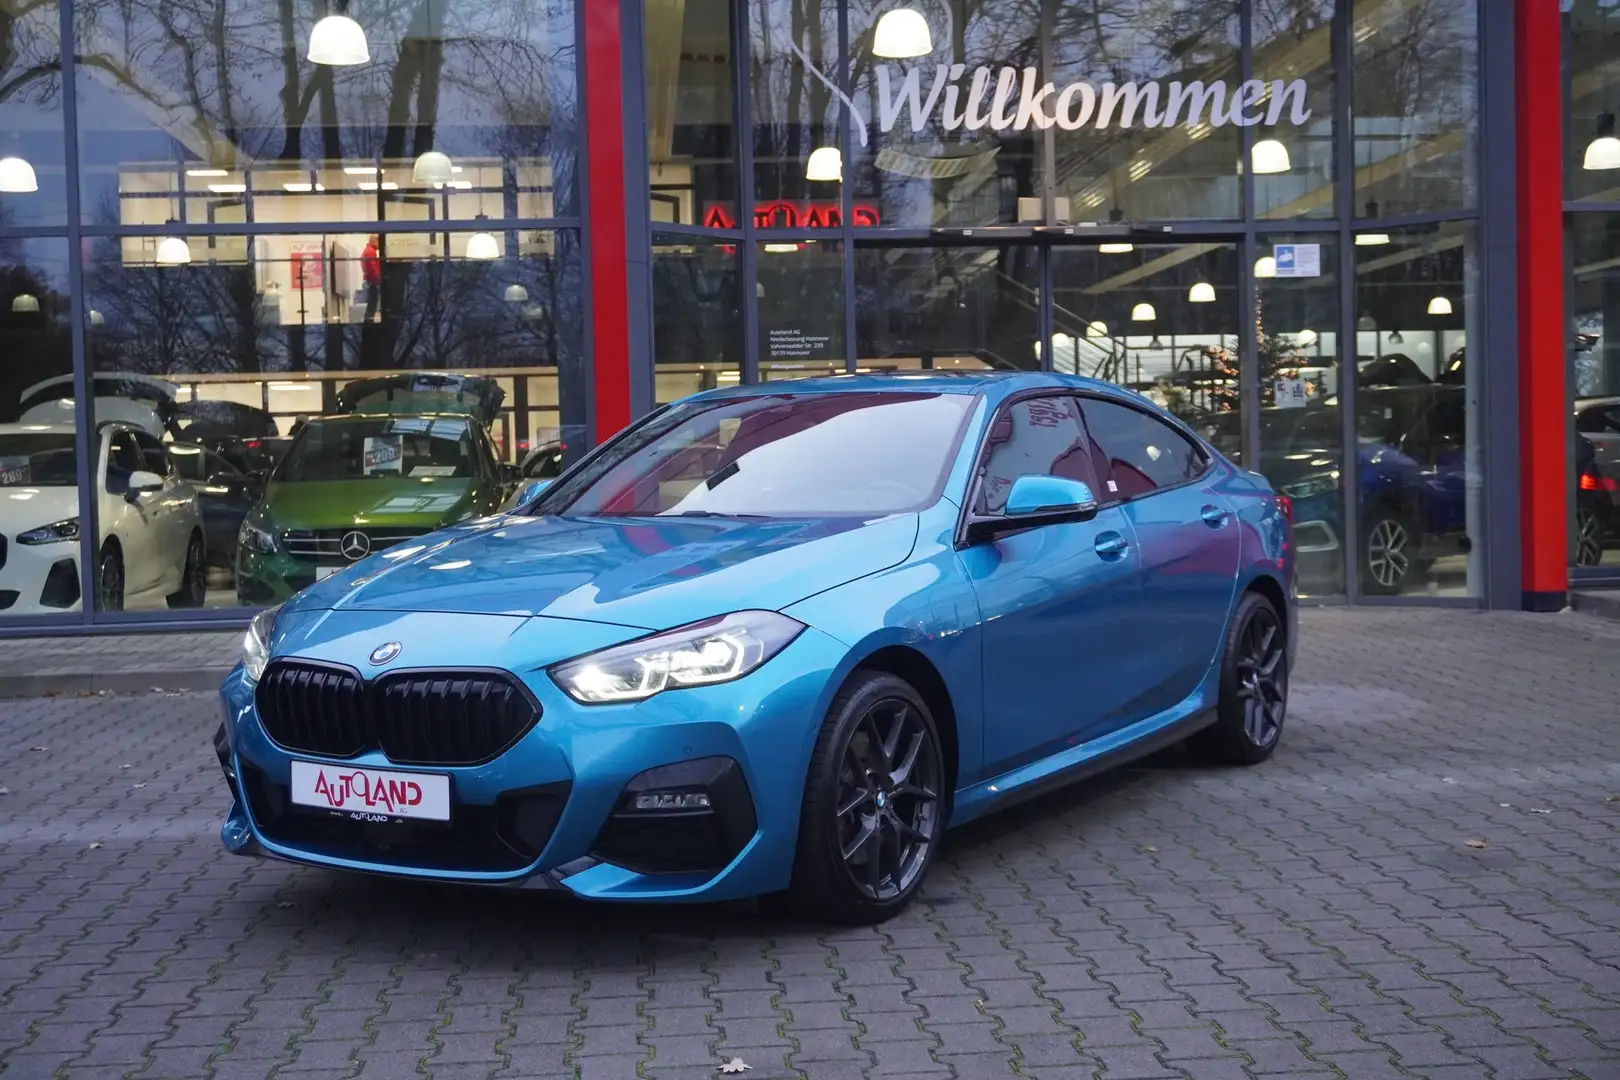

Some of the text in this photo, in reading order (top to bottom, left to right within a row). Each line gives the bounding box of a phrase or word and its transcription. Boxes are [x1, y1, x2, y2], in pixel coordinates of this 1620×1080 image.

[874, 63, 1311, 132] Willkommen
[315, 769, 422, 812] AUTOLAND
[350, 812, 388, 822] AUTOLAND
